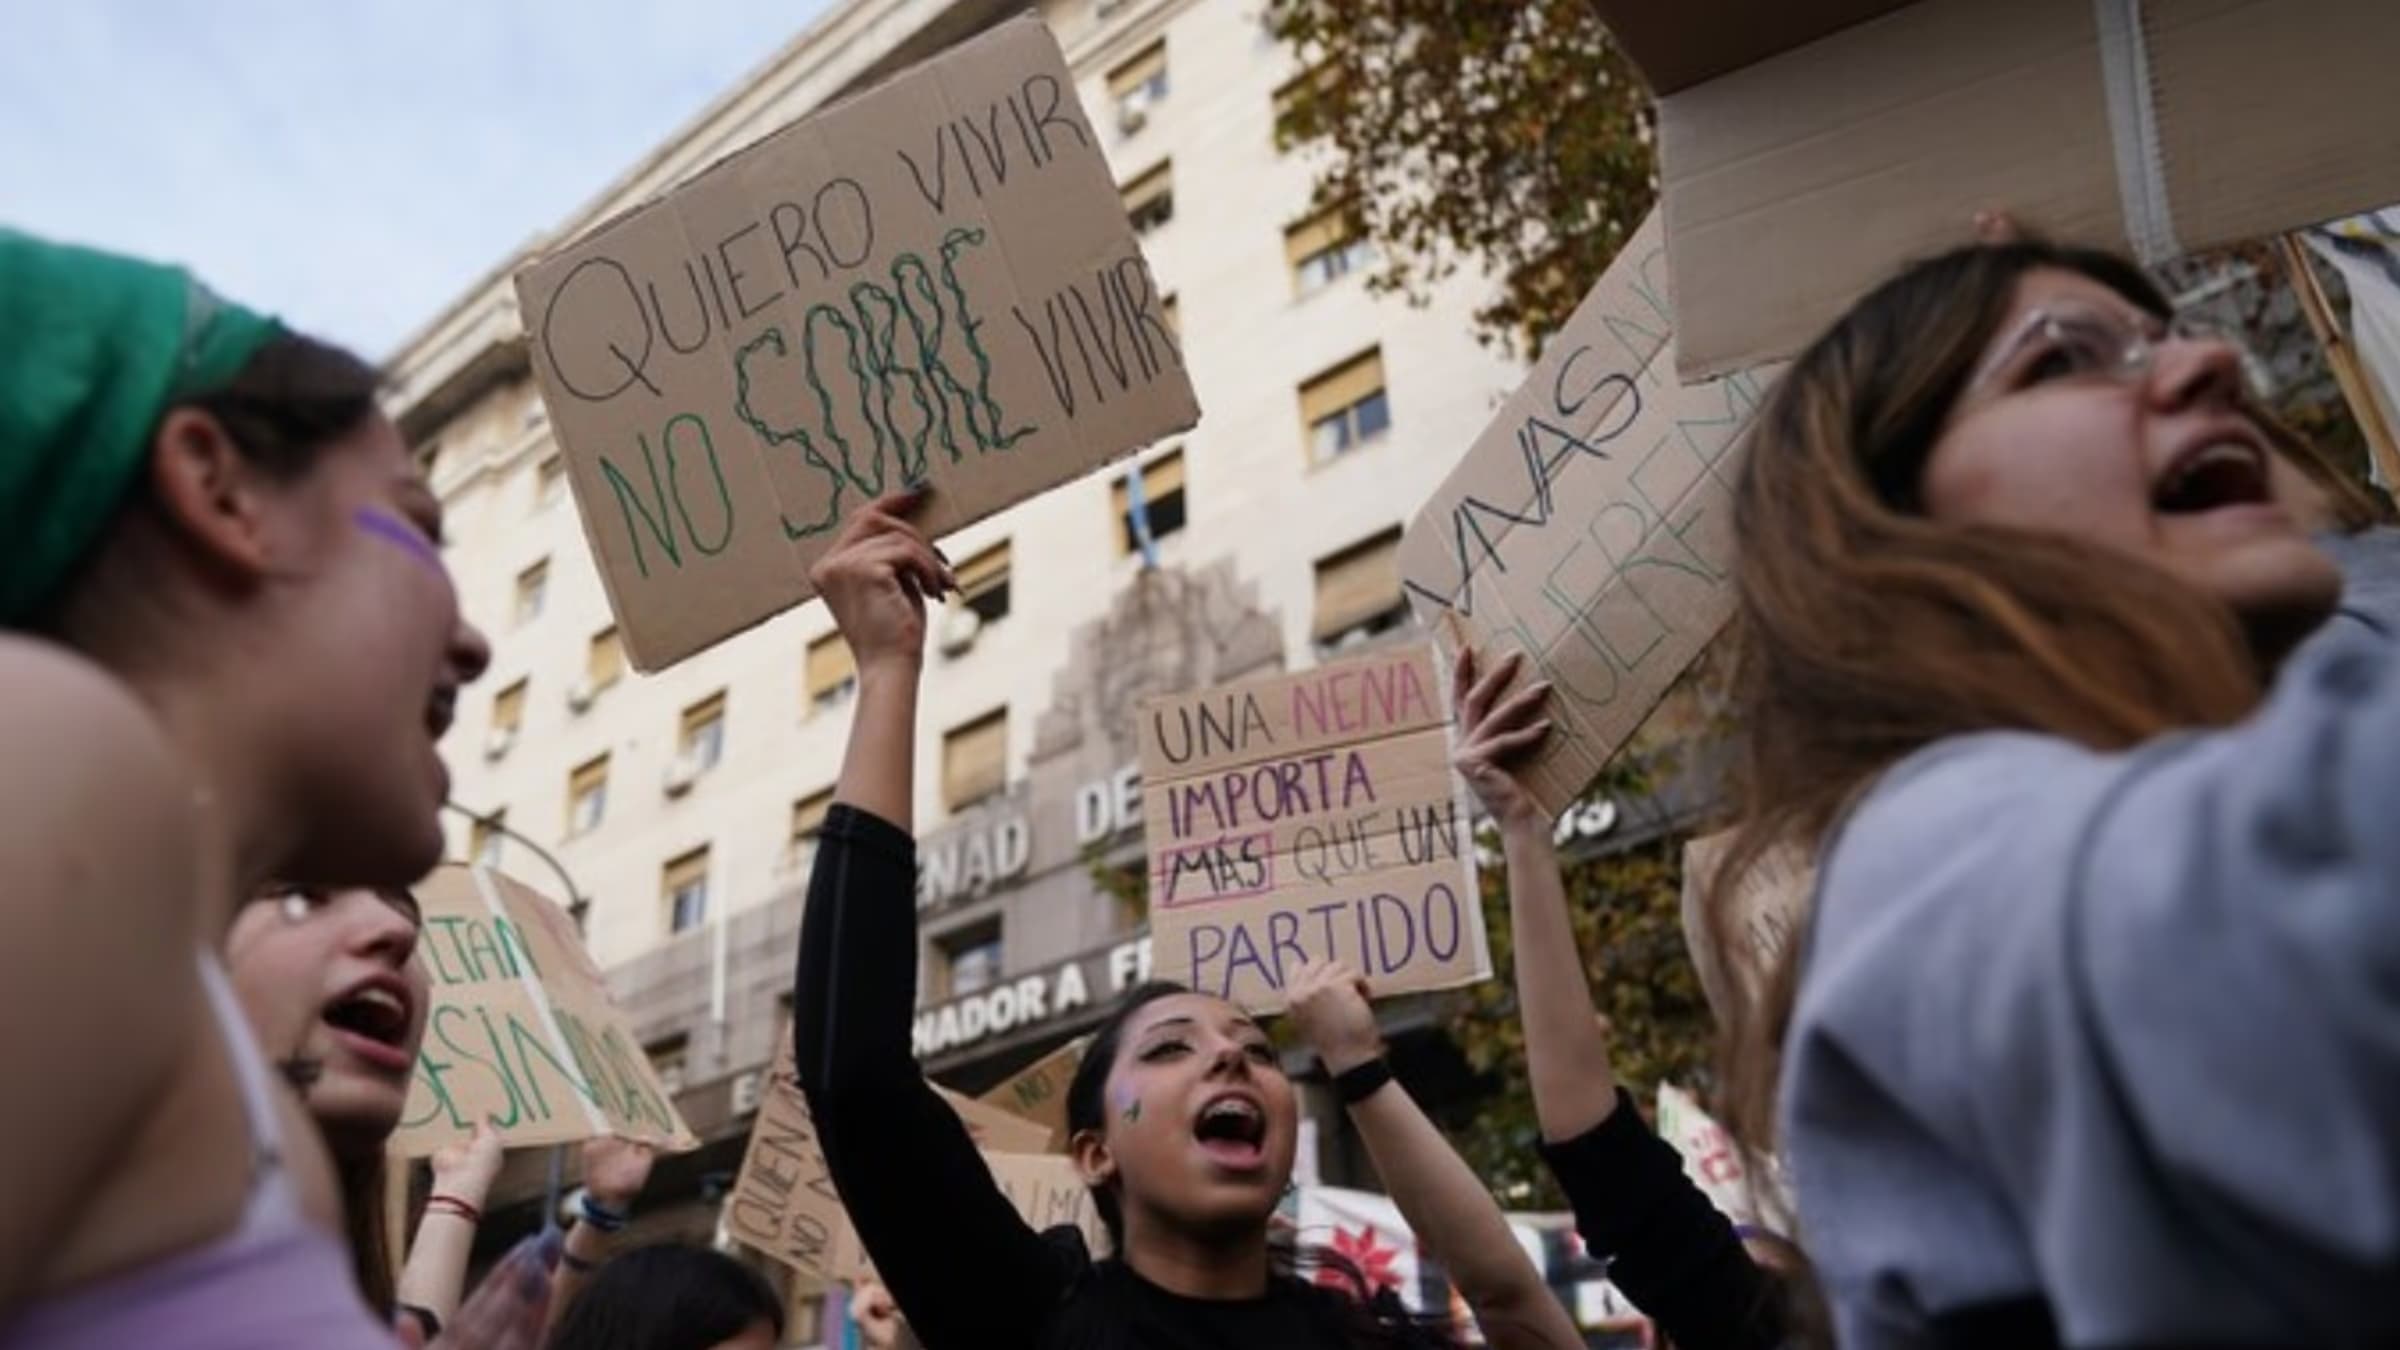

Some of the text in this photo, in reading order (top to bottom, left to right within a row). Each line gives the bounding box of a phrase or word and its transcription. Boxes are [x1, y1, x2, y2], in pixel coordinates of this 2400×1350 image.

[543, 74, 1089, 401] QUIERO VIVIR
[600, 228, 1181, 578] NO SOBRE VIVIR
[1153, 661, 1433, 765] UNA NENA
[1076, 763, 1144, 846] DE
[1167, 751, 1376, 840] IMPORTA
[1164, 832, 1267, 902] MÁS
[1293, 811, 1383, 887] QUE
[1397, 801, 1459, 867] UN
[422, 916, 544, 985] LTAN
[1188, 881, 1461, 1001] PARTIDO
